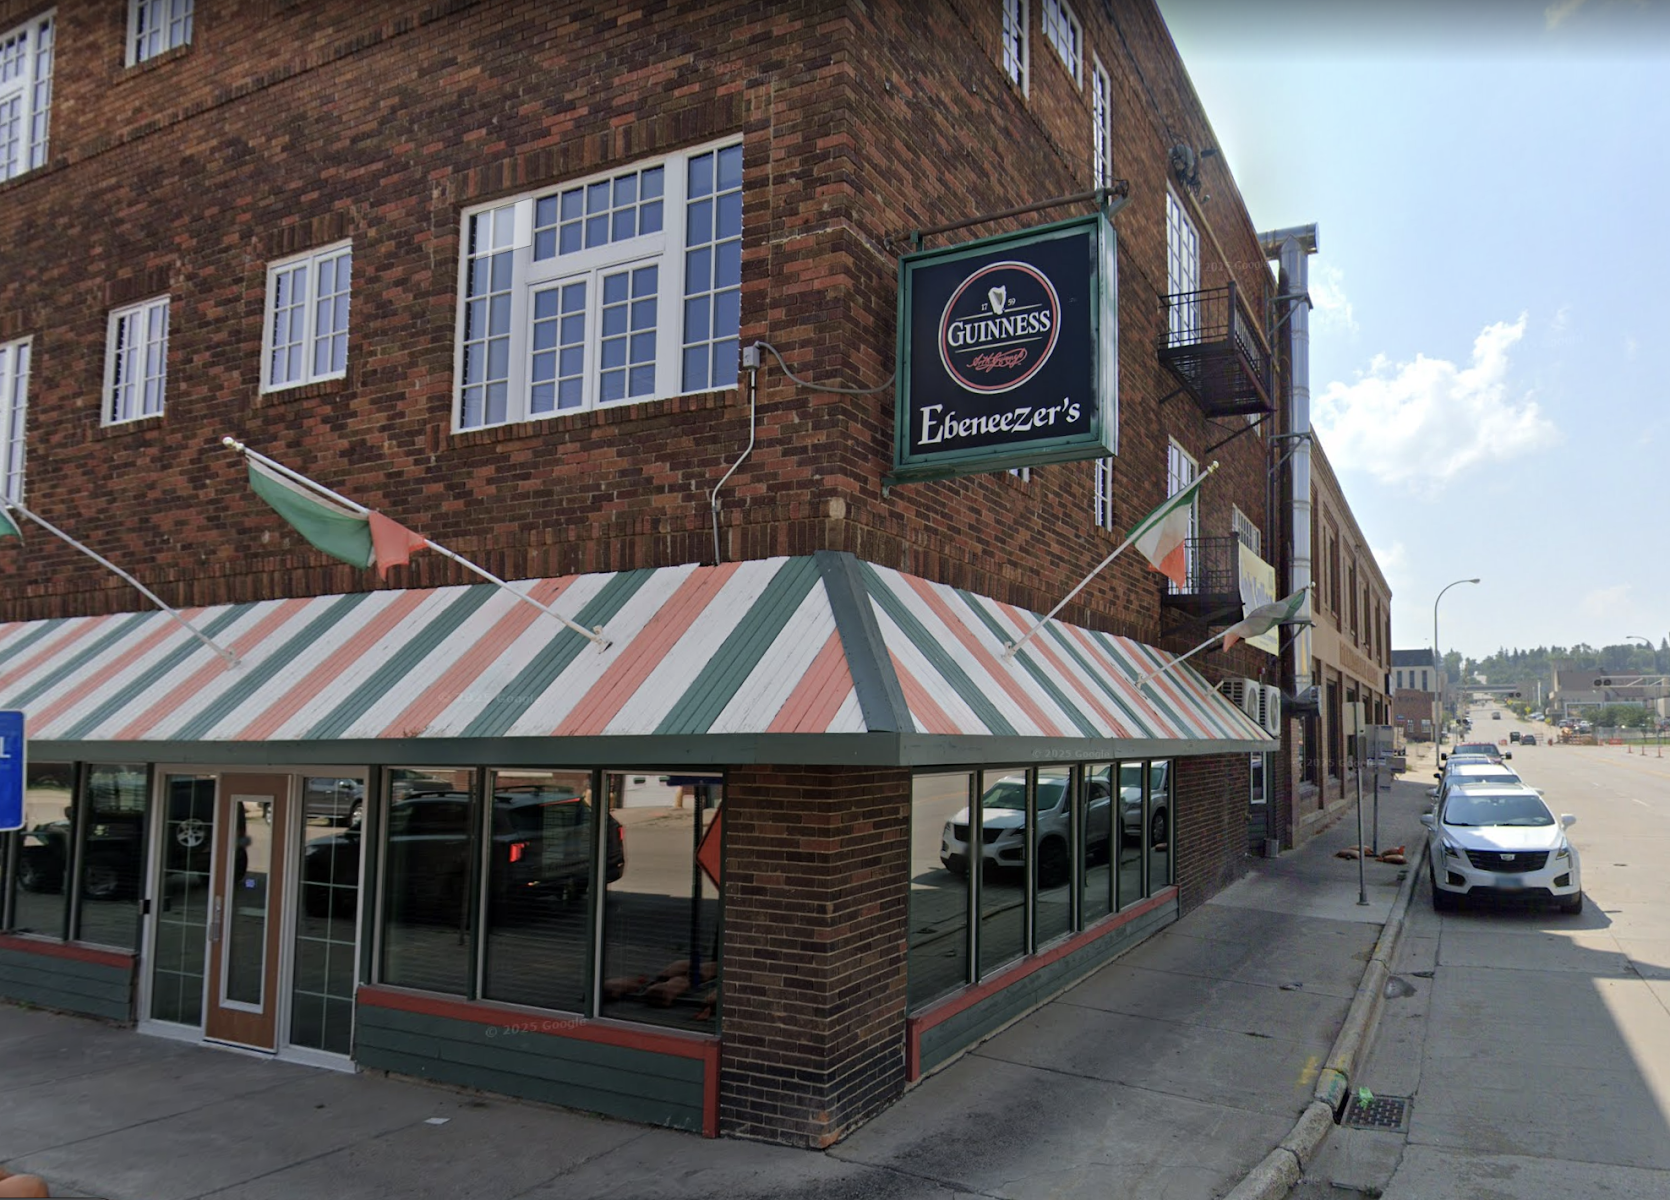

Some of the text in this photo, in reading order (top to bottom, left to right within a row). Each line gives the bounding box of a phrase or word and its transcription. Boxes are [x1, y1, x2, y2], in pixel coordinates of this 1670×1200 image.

[981, 297, 1016, 311] 17 59
[947, 309, 1051, 347] GUINNESS
[917, 396, 1081, 445] Ebeneezer's
